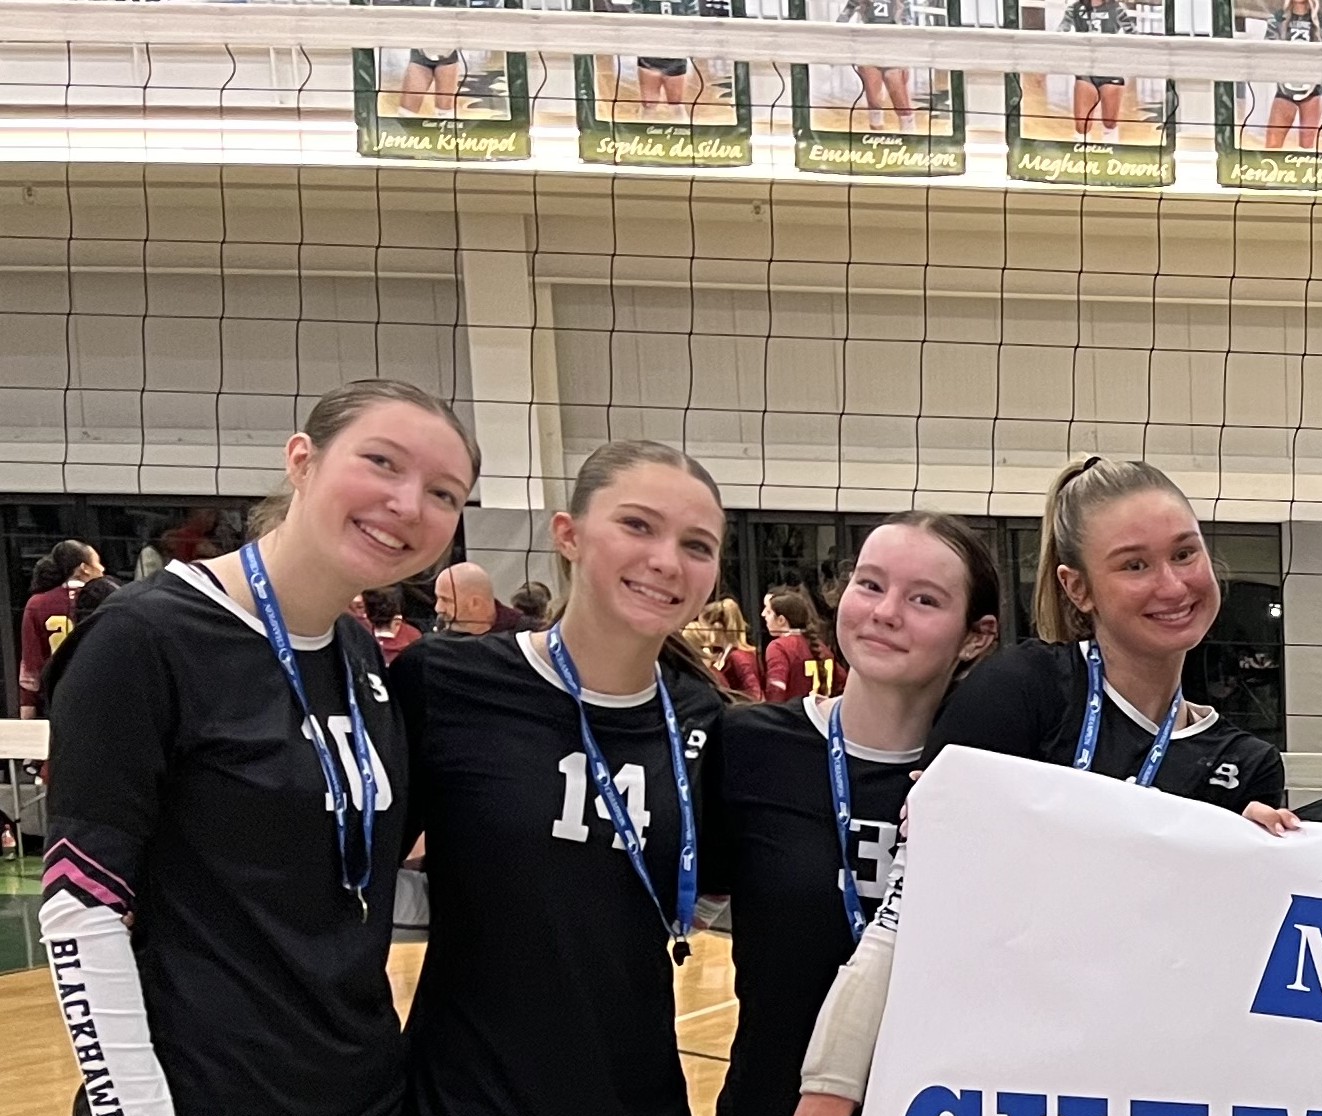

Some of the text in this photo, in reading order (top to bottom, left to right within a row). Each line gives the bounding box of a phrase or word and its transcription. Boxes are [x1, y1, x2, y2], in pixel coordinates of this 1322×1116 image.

[873, 2, 889, 17] 21
[372, 131, 432, 152] Jenna
[596, 135, 666, 163] Sophia
[861, 134, 904, 148] Captain
[809, 144, 958, 169] Emma Johnson
[1018, 152, 1169, 181] Meghan Downs
[1230, 158, 1298, 184] Kendra
[551, 751, 651, 853] 14
